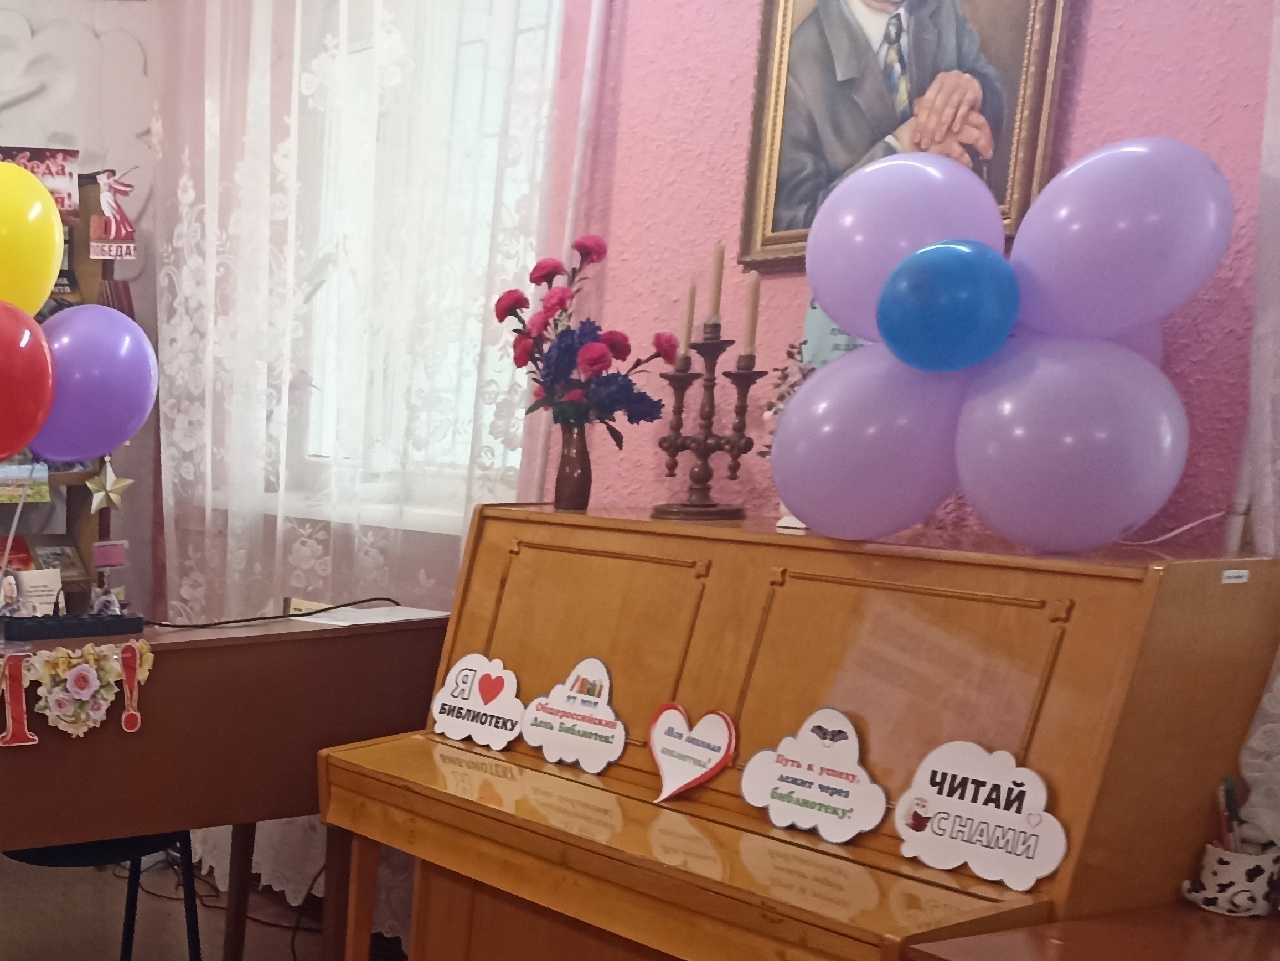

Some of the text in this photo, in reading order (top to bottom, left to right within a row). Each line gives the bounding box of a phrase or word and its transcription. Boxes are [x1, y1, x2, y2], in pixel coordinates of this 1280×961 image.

[451, 667, 477, 701] Я
[438, 702, 519, 732] БИБЛИОТЕКУ
[928, 769, 1027, 815] ЧИТАЙ
[949, 814, 1040, 861] НАМИ
